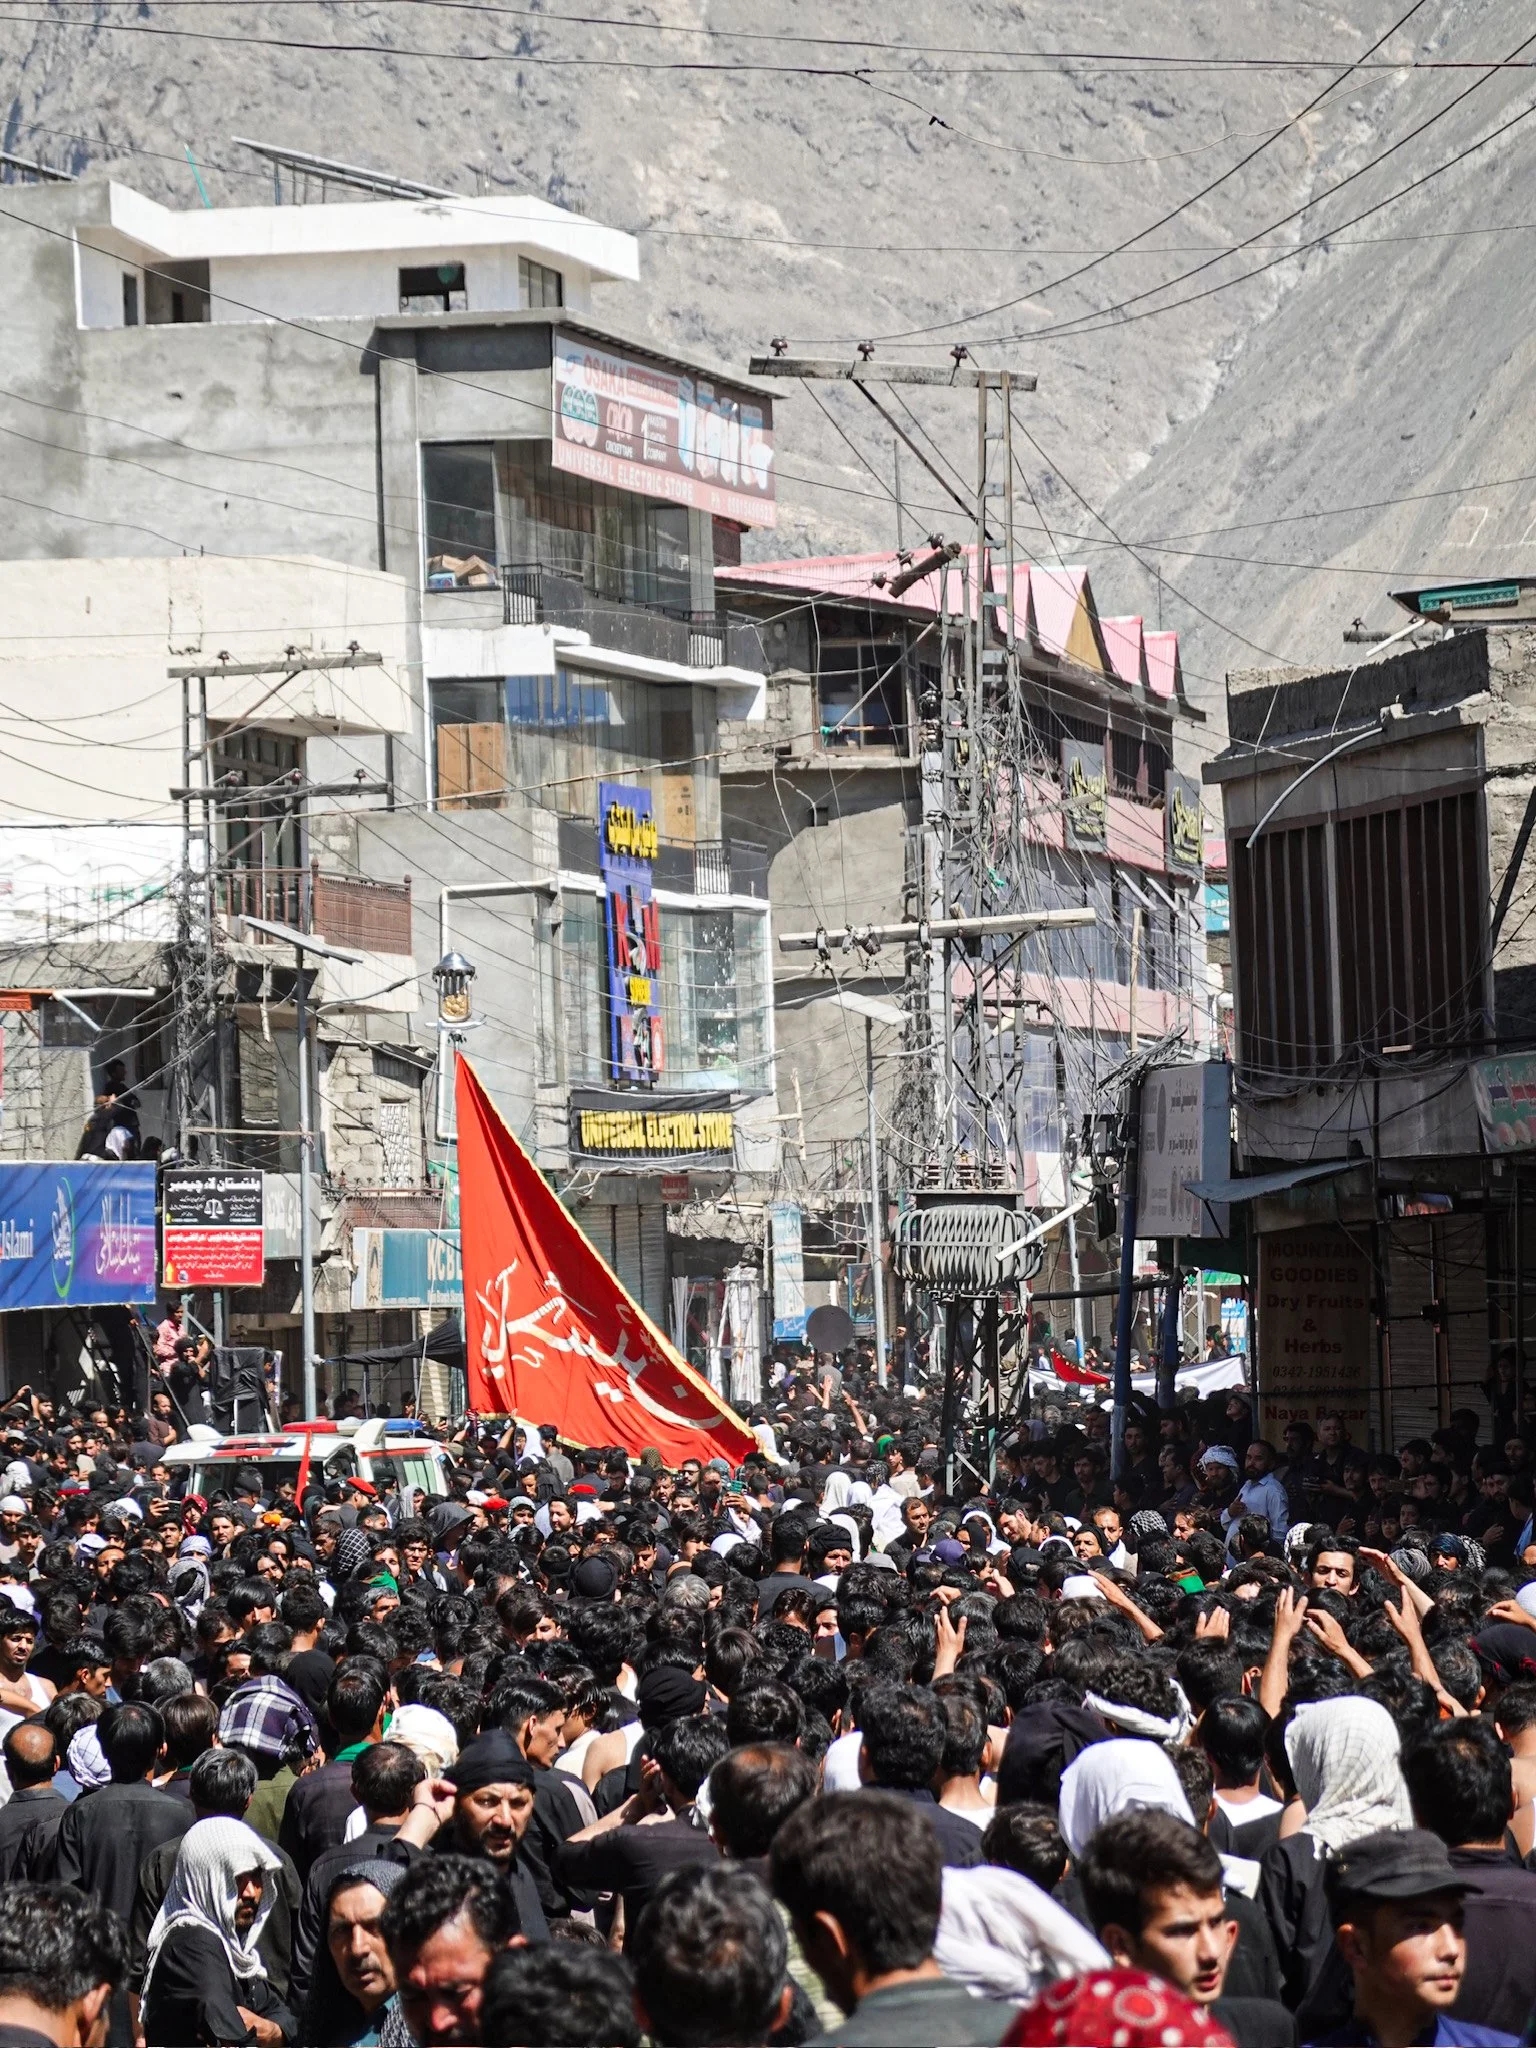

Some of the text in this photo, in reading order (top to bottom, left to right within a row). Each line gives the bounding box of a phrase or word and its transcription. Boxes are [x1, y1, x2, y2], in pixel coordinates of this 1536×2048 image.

[558, 449, 614, 481] UNIVERSAL
[618, 463, 663, 493] ELECTRIC
[665, 477, 694, 502] STORE
[581, 1110, 733, 1148] UNIVERSAL ELECTRIC STORE
[0, 1218, 33, 1261] Islami
[1266, 1242, 1365, 1258] MOUNTAIN
[1270, 1267, 1360, 1283] GOODIES
[1265, 1294, 1365, 1312] Dry Fruits
[1302, 1318, 1317, 1333] &
[1284, 1338, 1343, 1354] Herbs
[1264, 1406, 1310, 1423] Naya
